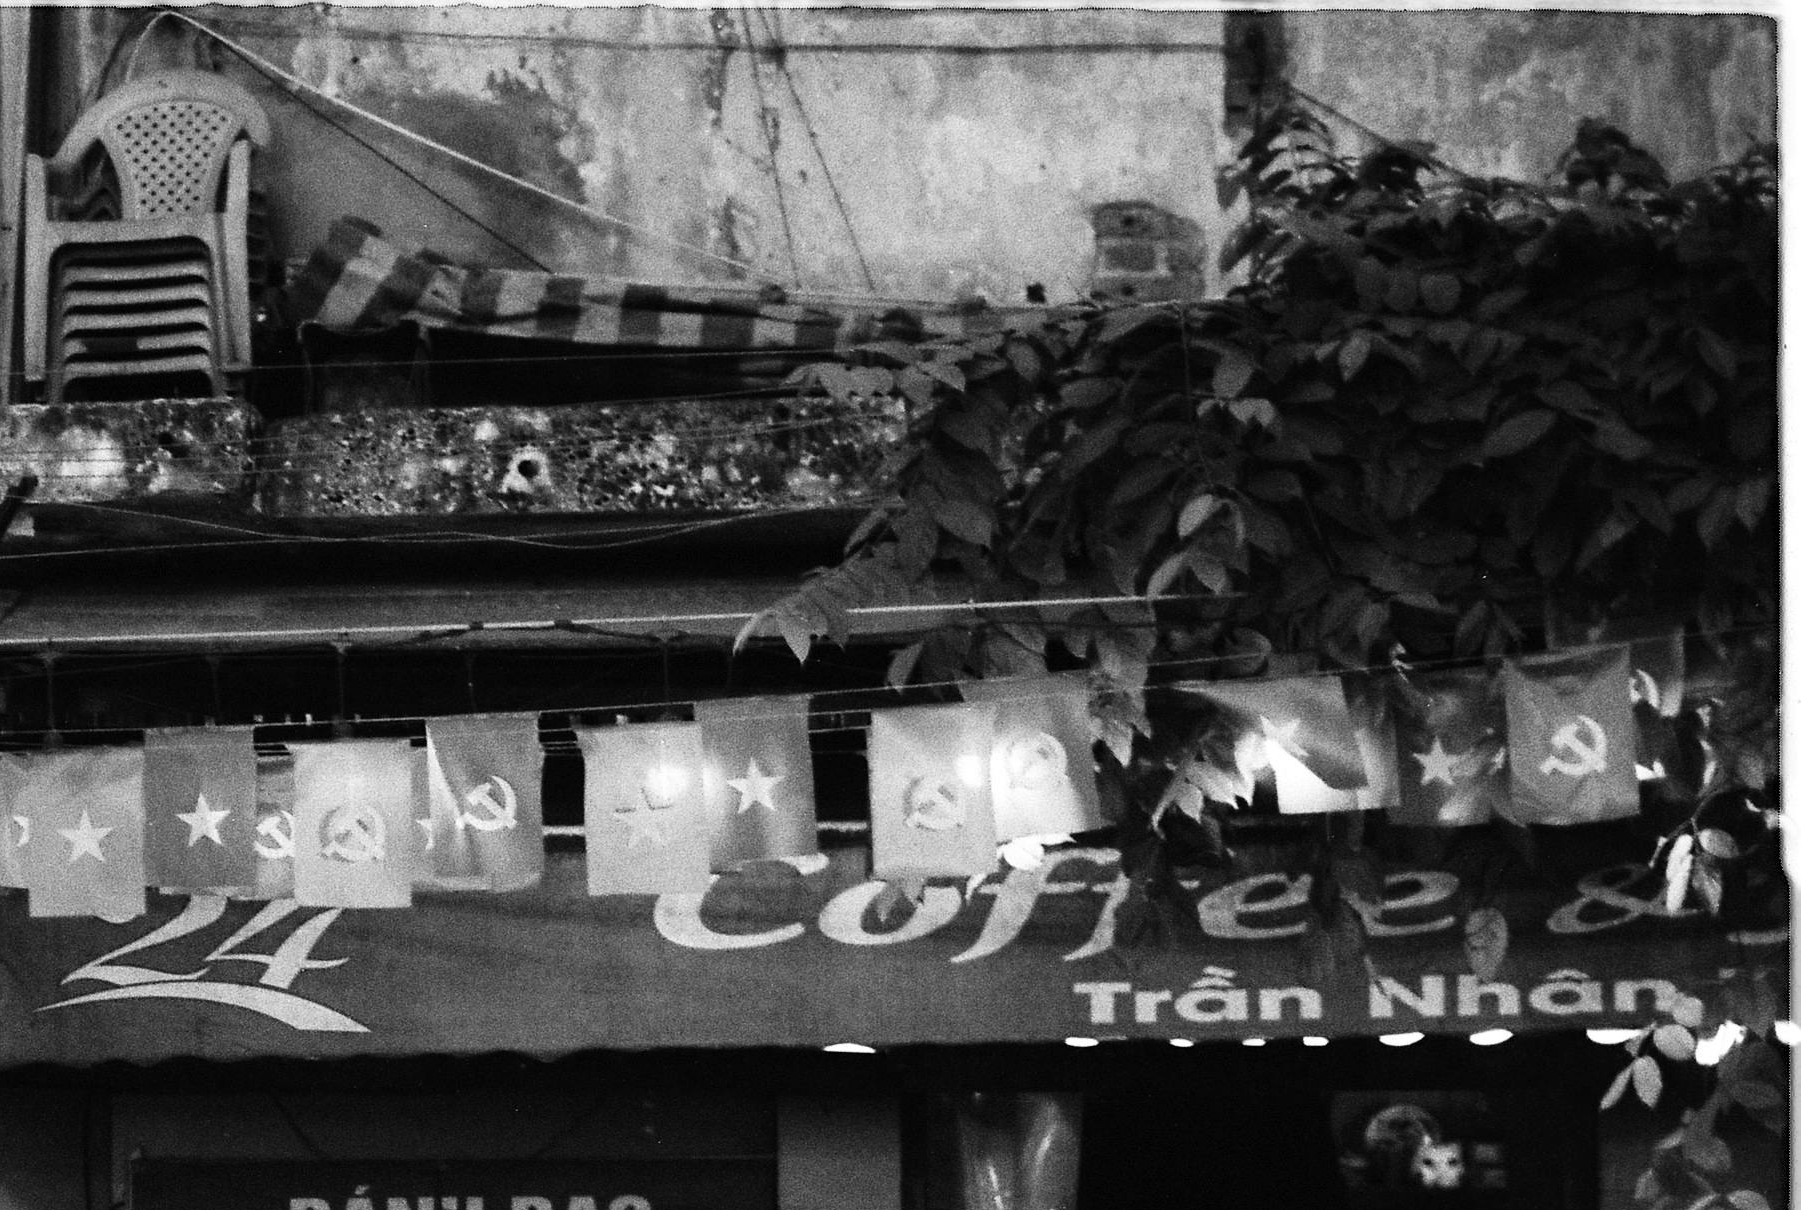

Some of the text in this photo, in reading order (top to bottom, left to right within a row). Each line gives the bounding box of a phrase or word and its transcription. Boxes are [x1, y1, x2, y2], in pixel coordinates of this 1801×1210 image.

[59, 893, 349, 988] 24
[654, 847, 1459, 963] Coffee
[1074, 966, 1679, 1023] Trần Nhân
